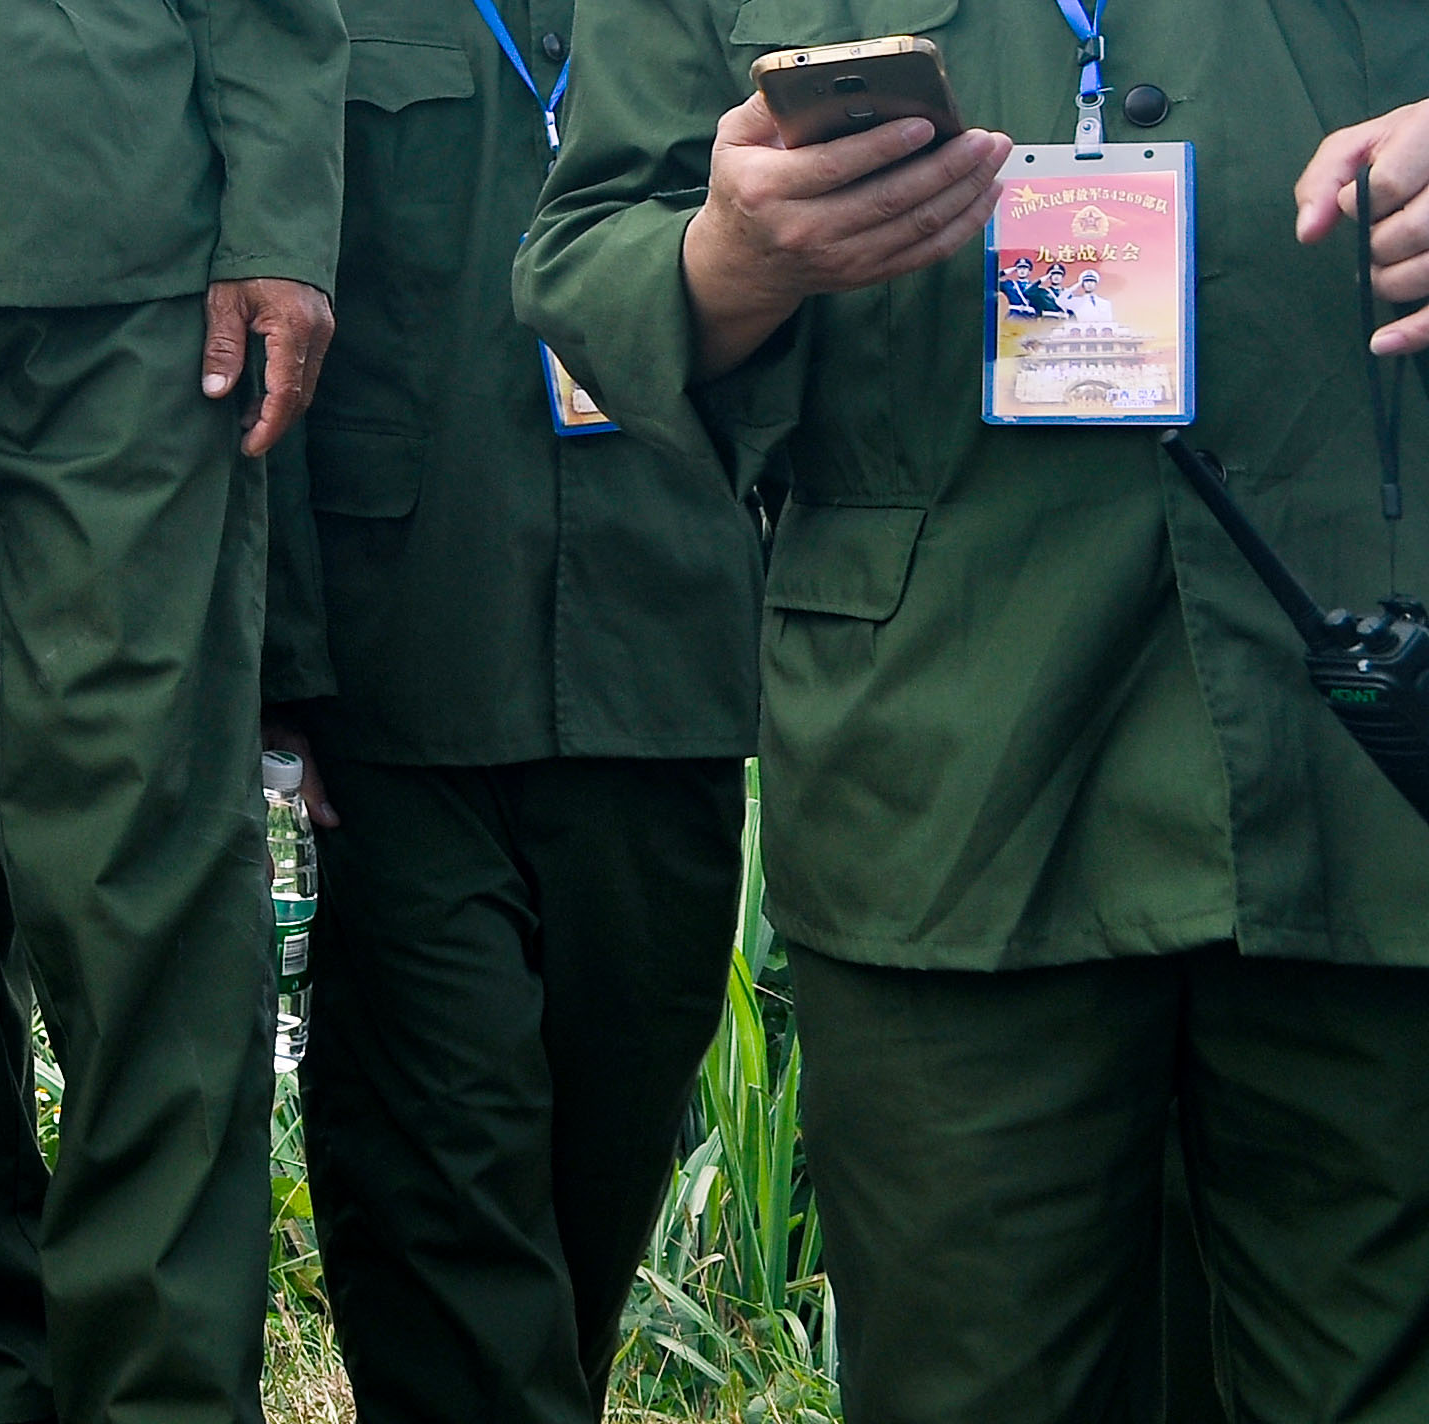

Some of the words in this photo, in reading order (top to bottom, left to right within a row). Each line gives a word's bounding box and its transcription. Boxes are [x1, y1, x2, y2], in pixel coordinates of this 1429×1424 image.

[1010, 187, 1170, 220] 中国人民解放军54269部队
[1036, 242, 1140, 264] 九连战友会
